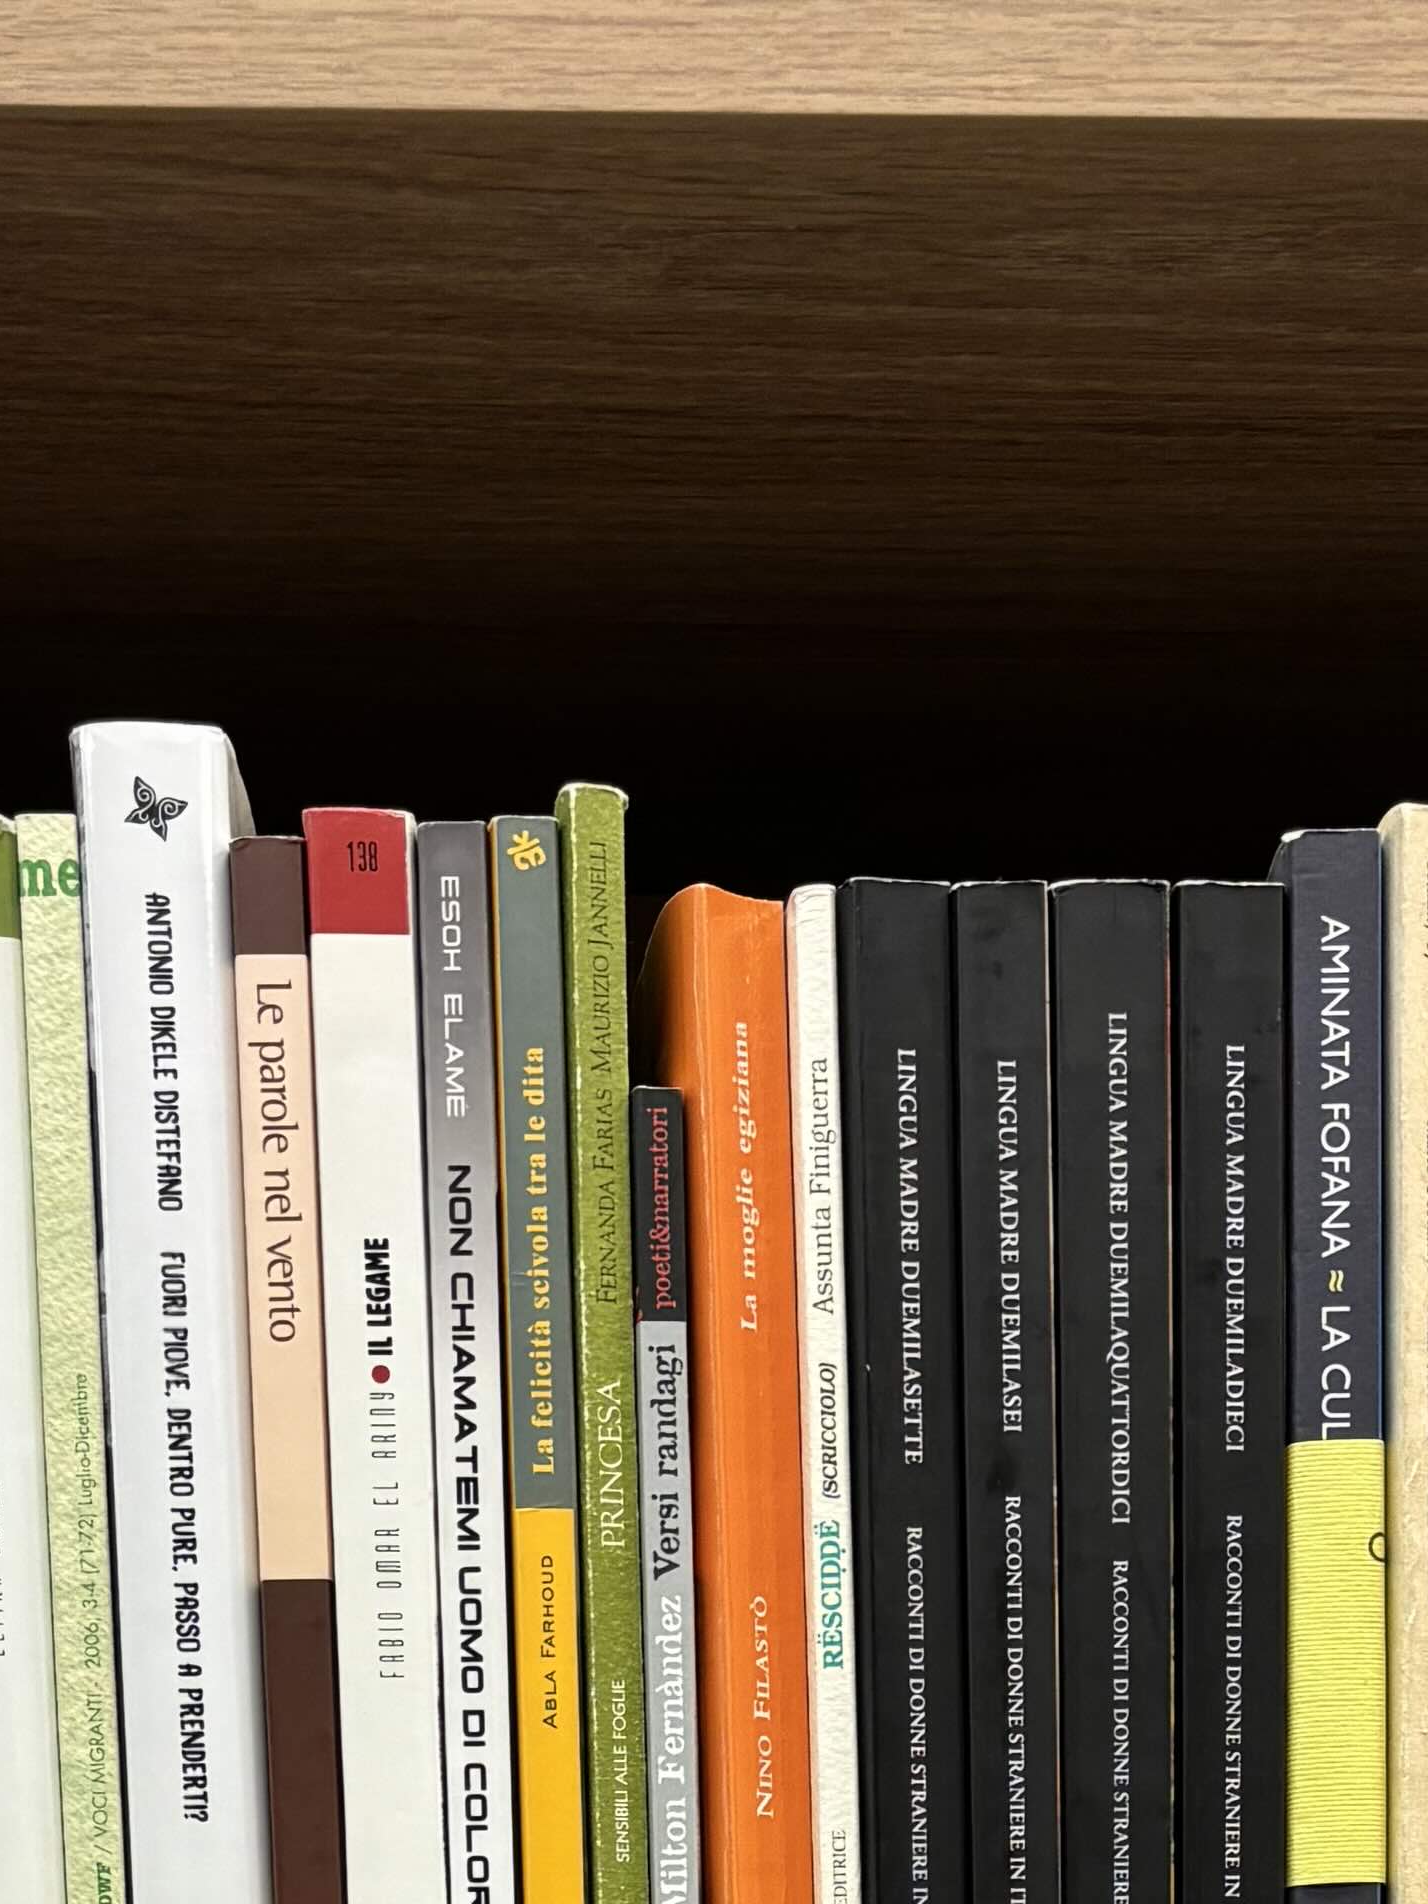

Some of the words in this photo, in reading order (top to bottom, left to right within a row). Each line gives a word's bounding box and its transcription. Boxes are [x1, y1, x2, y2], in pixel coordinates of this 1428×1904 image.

[256, 980, 292, 1024] Le
[250, 1039, 299, 1153] parole
[897, 1049, 917, 1149] LINGUA
[264, 1168, 303, 1222] nel
[448, 1165, 473, 1256] NON
[899, 1158, 919, 1253] MADRE
[266, 1235, 301, 1342] vento
[451, 1272, 480, 1551] CHIAMATEMI
[901, 1261, 923, 1464] DUEMILASETTE
[458, 1566, 484, 1694] UOMO
[462, 1709, 486, 1747] DI
